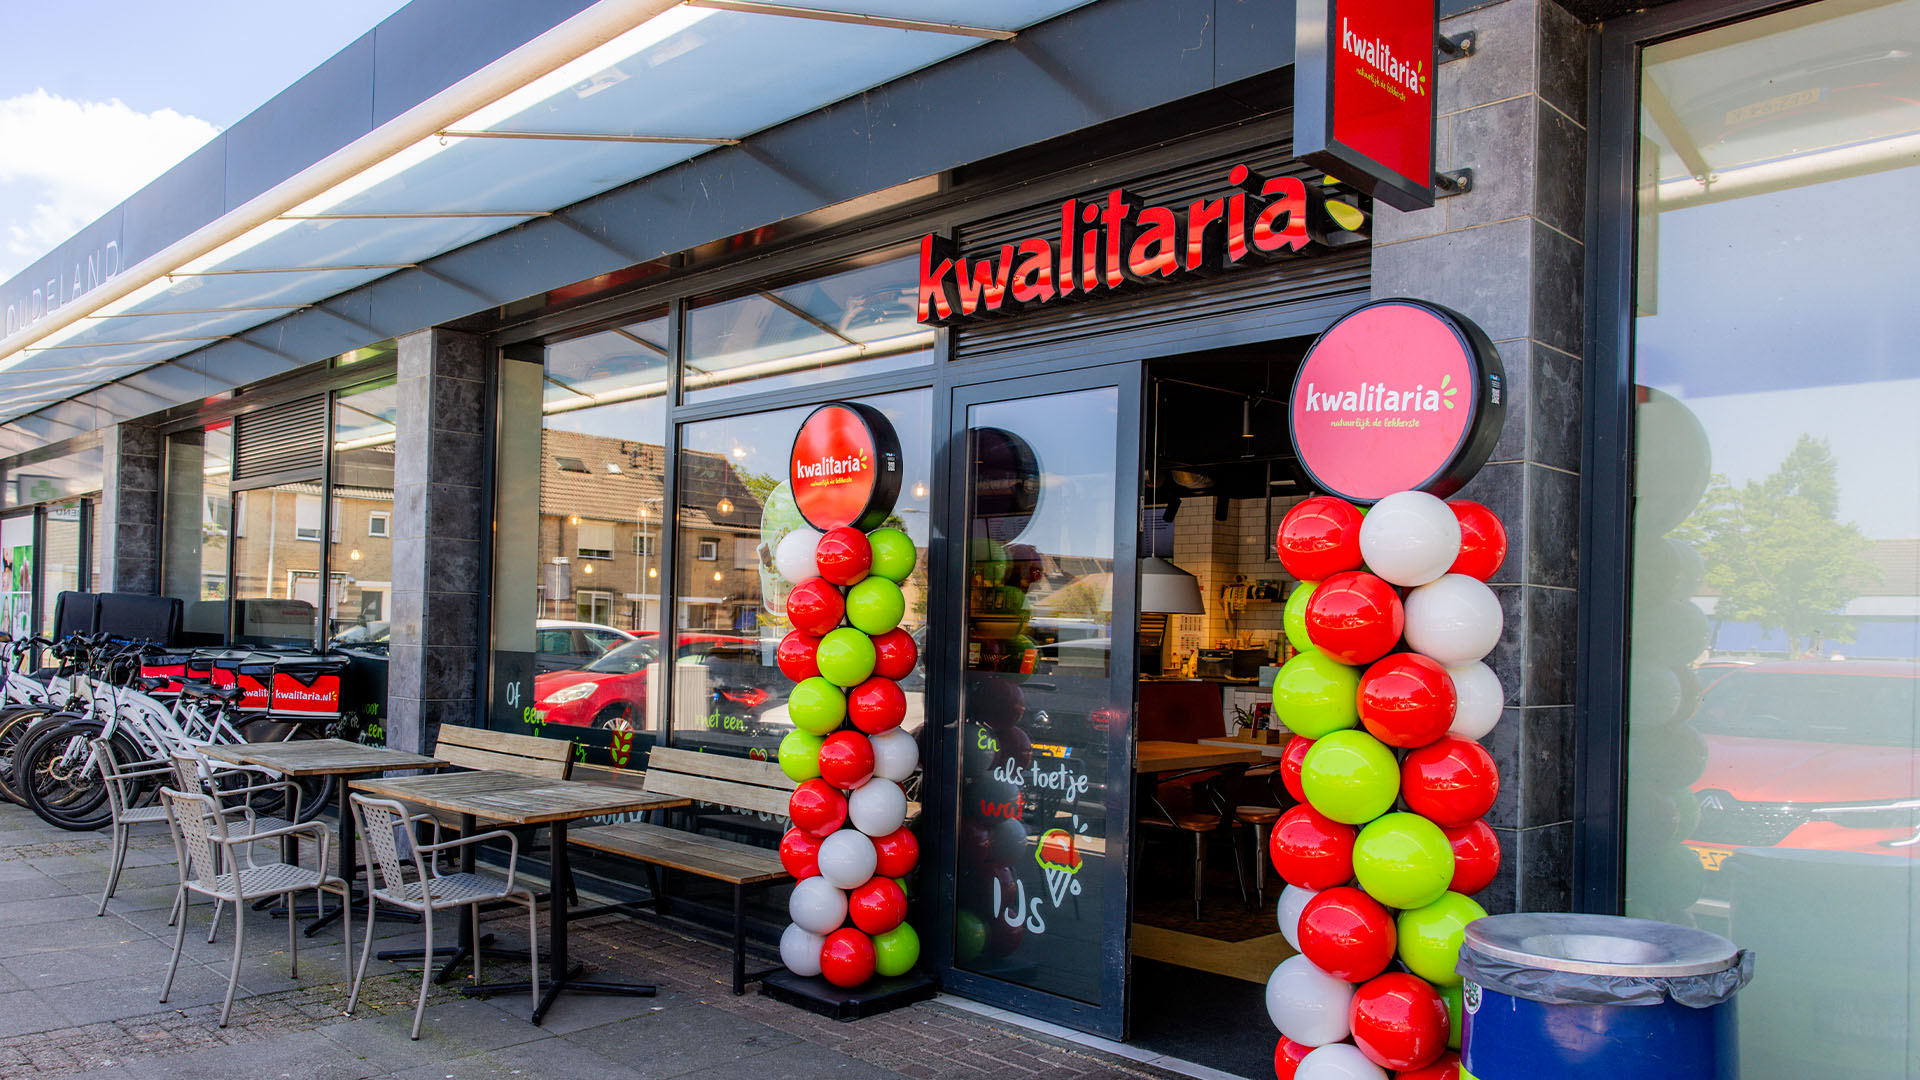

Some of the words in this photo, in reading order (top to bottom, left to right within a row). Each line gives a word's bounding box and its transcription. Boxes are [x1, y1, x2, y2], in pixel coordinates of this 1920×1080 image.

[1343, 17, 1418, 94] kwalitaria
[917, 164, 1312, 324] kwalitaria
[1306, 382, 1440, 412] kwalitaria
[1331, 418, 1370, 430] natuurlijk
[1372, 418, 1382, 427] de
[1384, 418, 1420, 427] lekkerste
[797, 455, 861, 479] kwalitaria
[275, 689, 331, 701] kwalitaria.nl
[506, 681, 521, 709] Of
[523, 706, 547, 727] een
[723, 716, 746, 732] een
[368, 723, 384, 740] een
[977, 728, 1000, 752] En
[993, 757, 1025, 786] als
[1030, 760, 1089, 803] toetje
[981, 791, 1026, 821] wat
